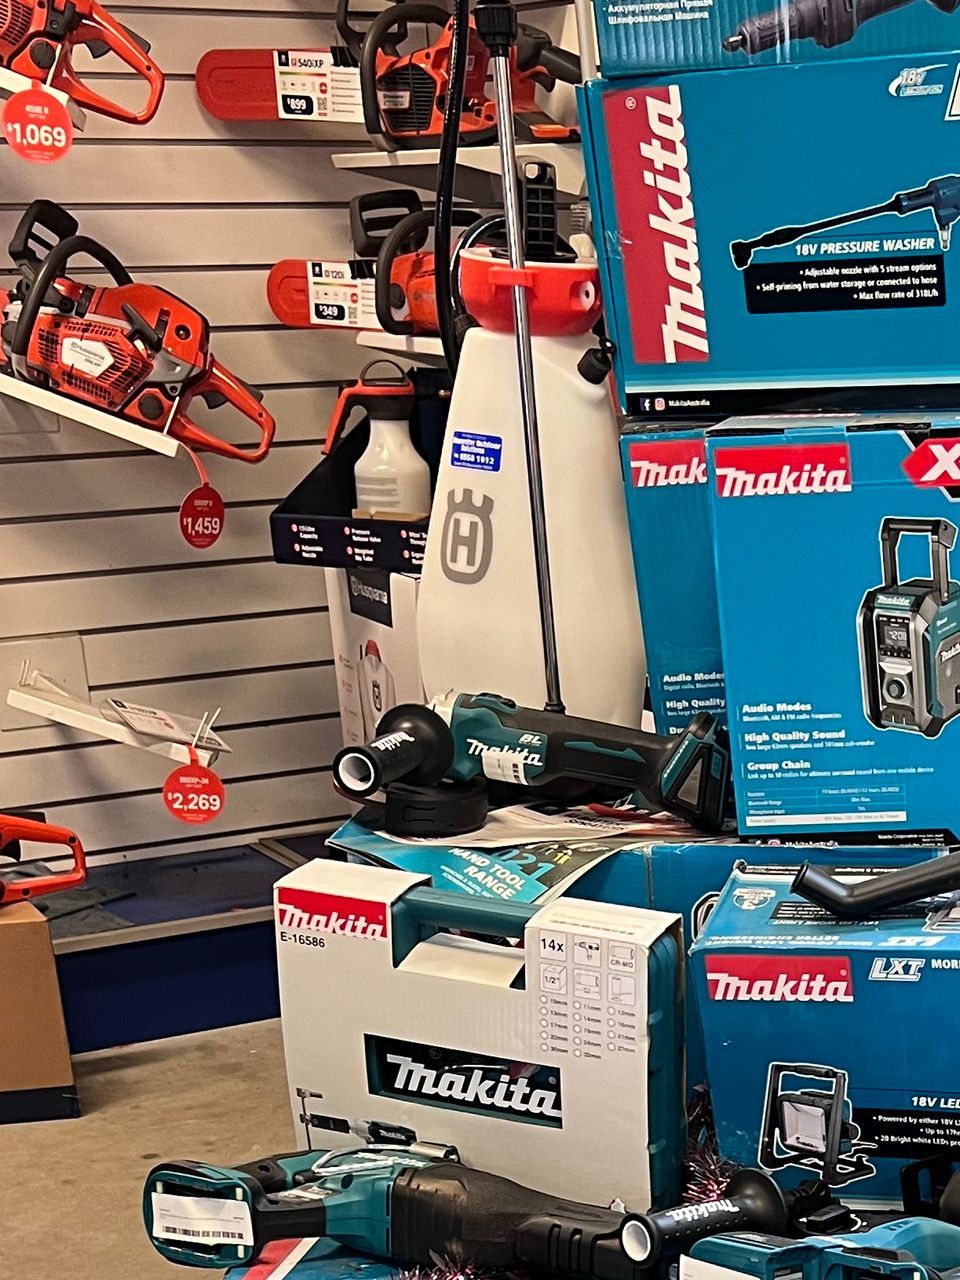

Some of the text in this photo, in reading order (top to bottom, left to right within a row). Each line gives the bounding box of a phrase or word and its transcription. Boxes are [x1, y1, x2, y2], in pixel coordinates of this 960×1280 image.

[287, 98, 306, 110] $899
[7, 122, 66, 148] $1,069
[795, 238, 935, 256] 18V PRESSURE WASHER
[805, 268, 839, 277] Adjustable
[863, 265, 878, 273] with
[886, 264, 909, 273] stream
[911, 263, 936, 273] options
[762, 275, 937, 293] Self-priming from water storage connected hose
[859, 290, 905, 300] Max flow rate
[319, 305, 338, 317] $349
[715, 463, 851, 498] makita
[183, 517, 221, 537] $1,459
[663, 673, 692, 683] Audio
[666, 698, 726, 710] High Quality
[742, 702, 812, 713] Audio Modes
[745, 730, 846, 743] High Quality Sound
[747, 760, 811, 772] Group Chain
[168, 791, 221, 811] $2,269
[449, 847, 490, 868] HAND
[489, 864, 526, 891] TOOL
[464, 865, 517, 900] RANGE
[279, 902, 388, 942] makita
[280, 931, 326, 949] E-16586
[540, 938, 565, 953] 14x
[868, 957, 926, 982] LXT
[707, 972, 854, 1002] makita
[386, 1053, 564, 1119] makita
[912, 1097, 937, 1108] 18V
[878, 1115, 907, 1123] Powered
[918, 1117, 938, 1125] either
[940, 1118, 954, 1126] 18V
[912, 1136, 932, 1144] white
